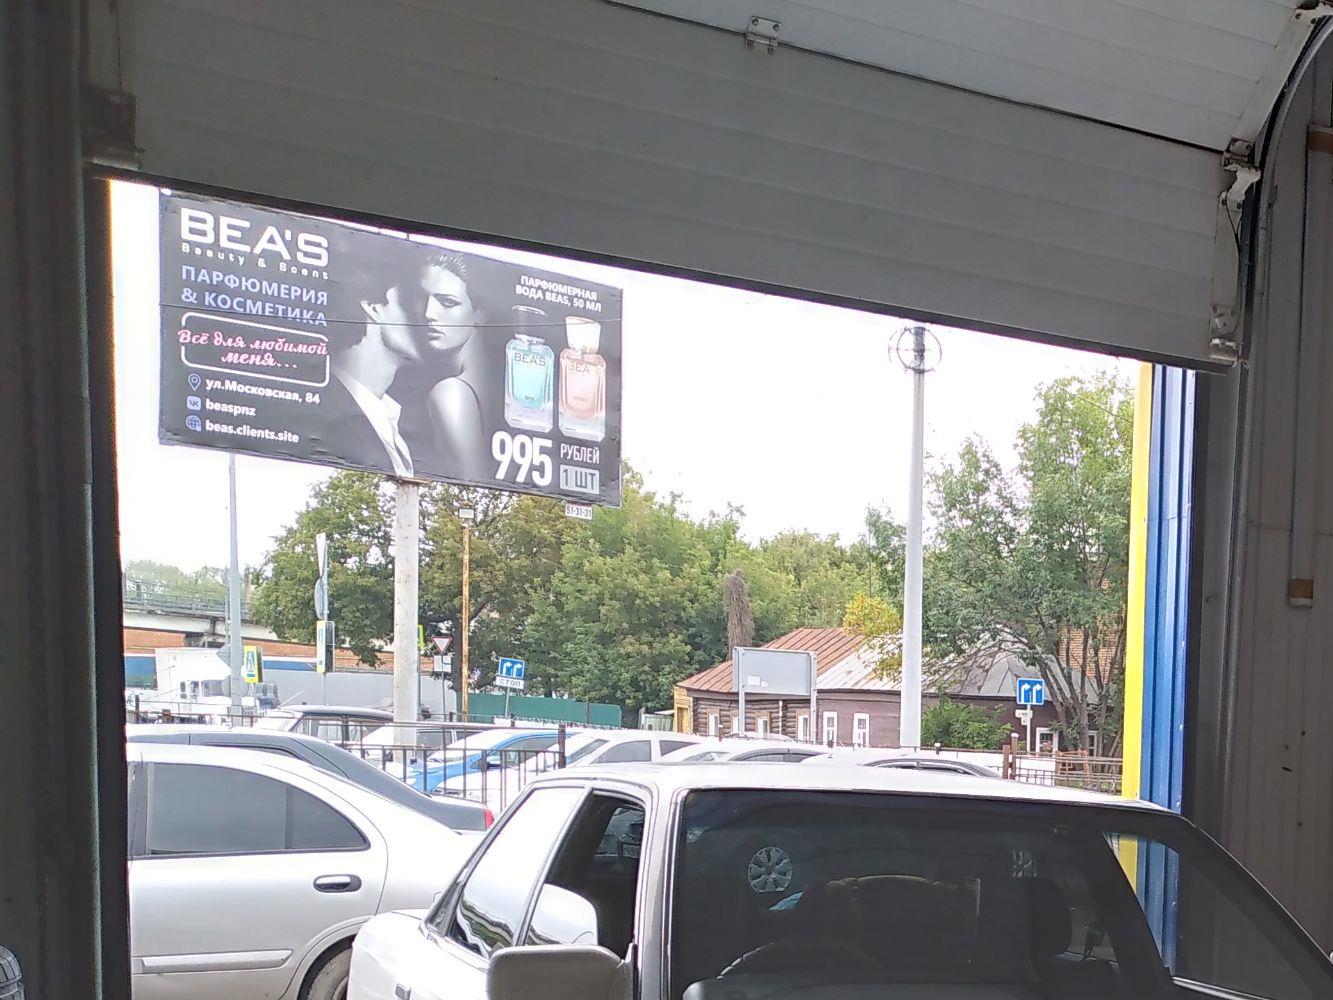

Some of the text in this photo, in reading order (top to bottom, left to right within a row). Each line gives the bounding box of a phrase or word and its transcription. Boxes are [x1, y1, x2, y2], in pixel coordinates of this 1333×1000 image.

[181, 208, 328, 266] BEA'S
[182, 243, 328, 279] Beauty & Scent
[182, 265, 328, 305] ПАРФЮМЕРИЯ
[521, 275, 598, 301] ПАРФЮМЕРНАЯ
[181, 288, 327, 326] & КОСМЕТИКА
[515, 285, 602, 312] ВОДА BEAS, 50 МЛ
[178, 330, 328, 355] Всё для любимой
[205, 399, 256, 417] beaspnz
[305, 393, 321, 404] 84
[205, 420, 300, 443] beas.clients.site
[492, 430, 552, 487] 995
[560, 443, 600, 464] РУБЛЕЙ
[562, 468, 596, 490] 1 ШТ
